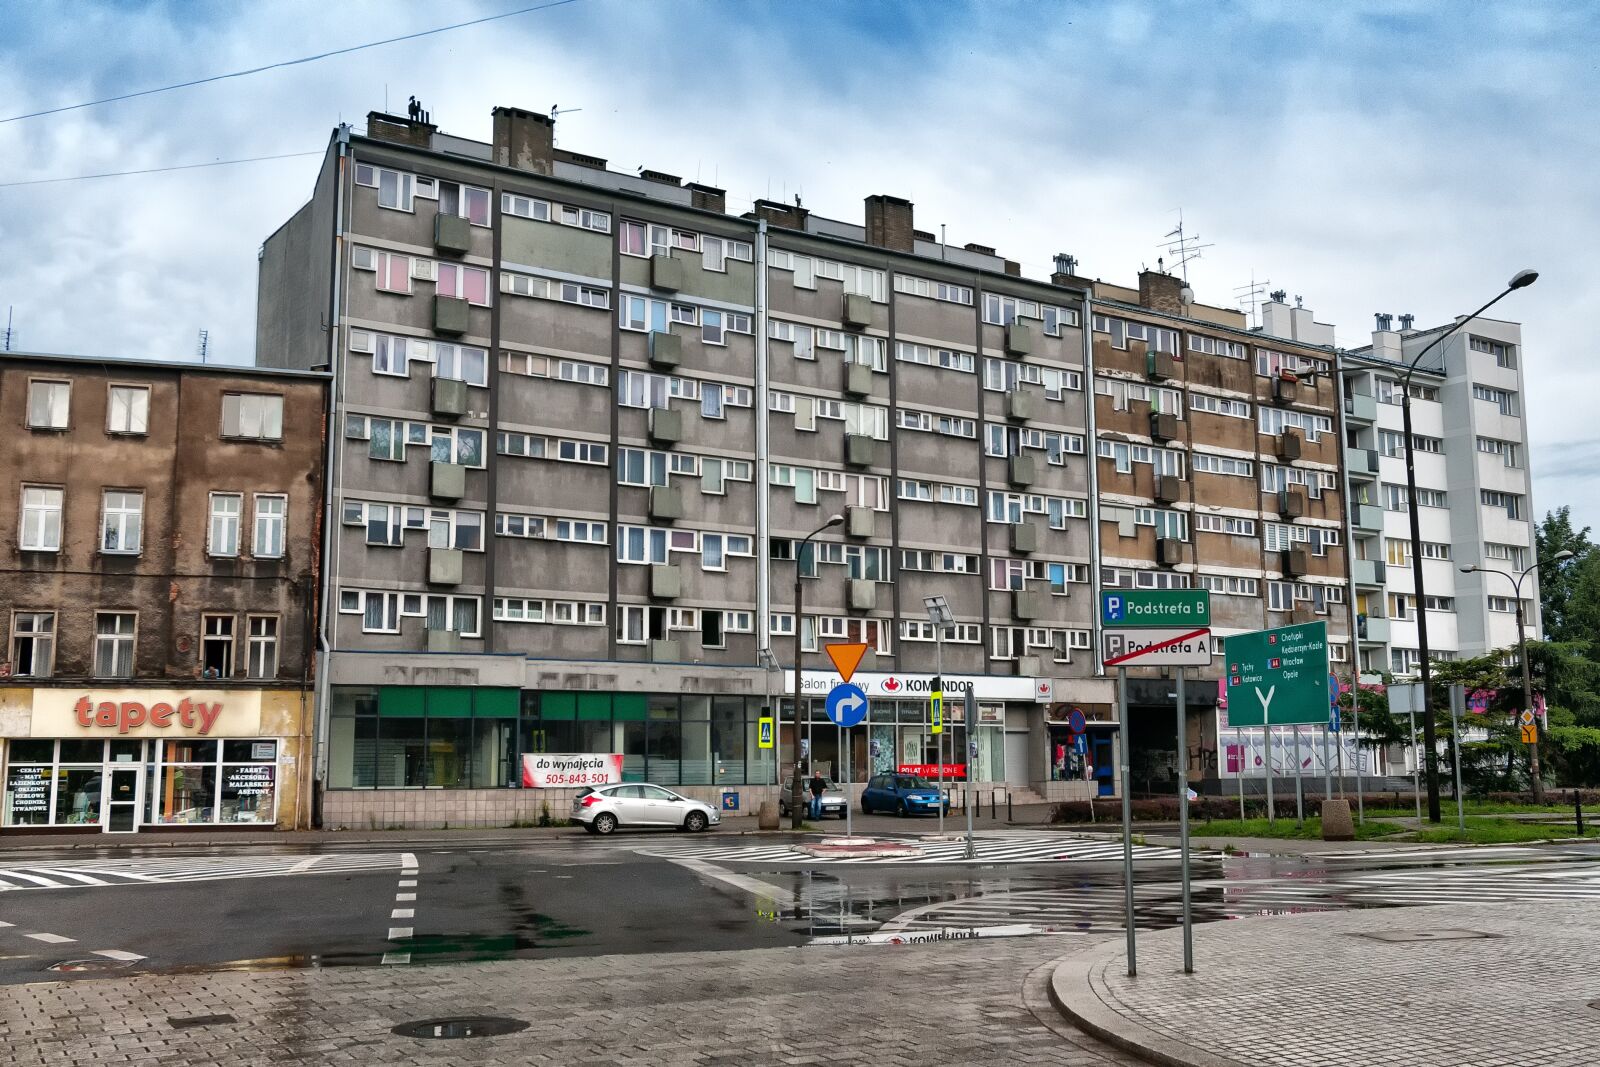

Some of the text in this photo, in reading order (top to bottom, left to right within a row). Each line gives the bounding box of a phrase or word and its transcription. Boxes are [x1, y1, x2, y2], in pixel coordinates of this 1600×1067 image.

[1127, 602, 1191, 614] Podstrefa
[1197, 602, 1205, 614] B
[1197, 641, 1207, 653] A
[1283, 670, 1299, 680] Opole
[906, 680, 974, 692] KOMNDOR
[73, 695, 224, 735] tapety
[536, 758, 604, 771] do wynajęcia
[545, 774, 609, 784] 505-843-501
